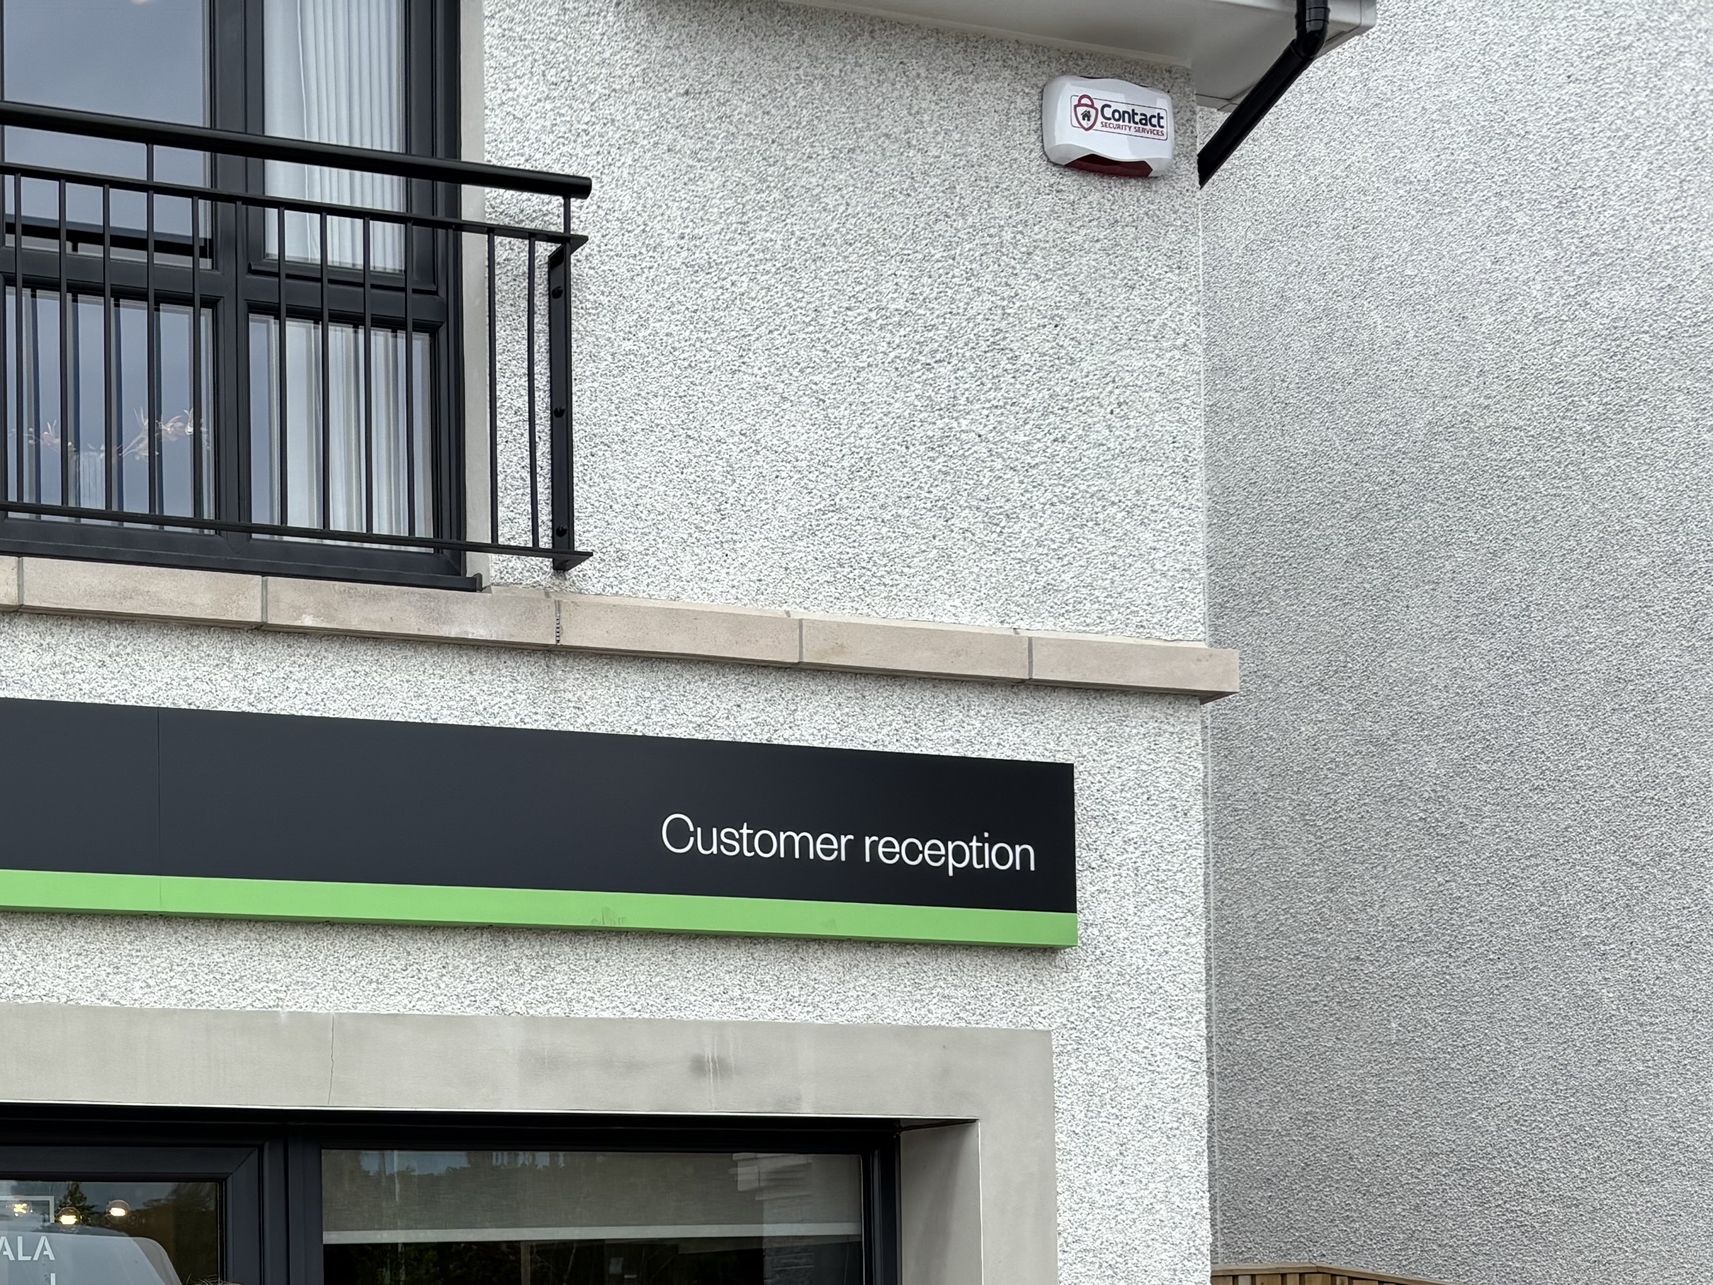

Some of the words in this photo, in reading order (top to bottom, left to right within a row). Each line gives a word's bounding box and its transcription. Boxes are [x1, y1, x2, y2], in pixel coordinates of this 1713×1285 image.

[1100, 103, 1165, 129] Contact
[1101, 121, 1132, 131] SECURITY
[1134, 126, 1164, 136] SERVICES
[661, 813, 854, 862] Customer
[865, 831, 1035, 877] reception
